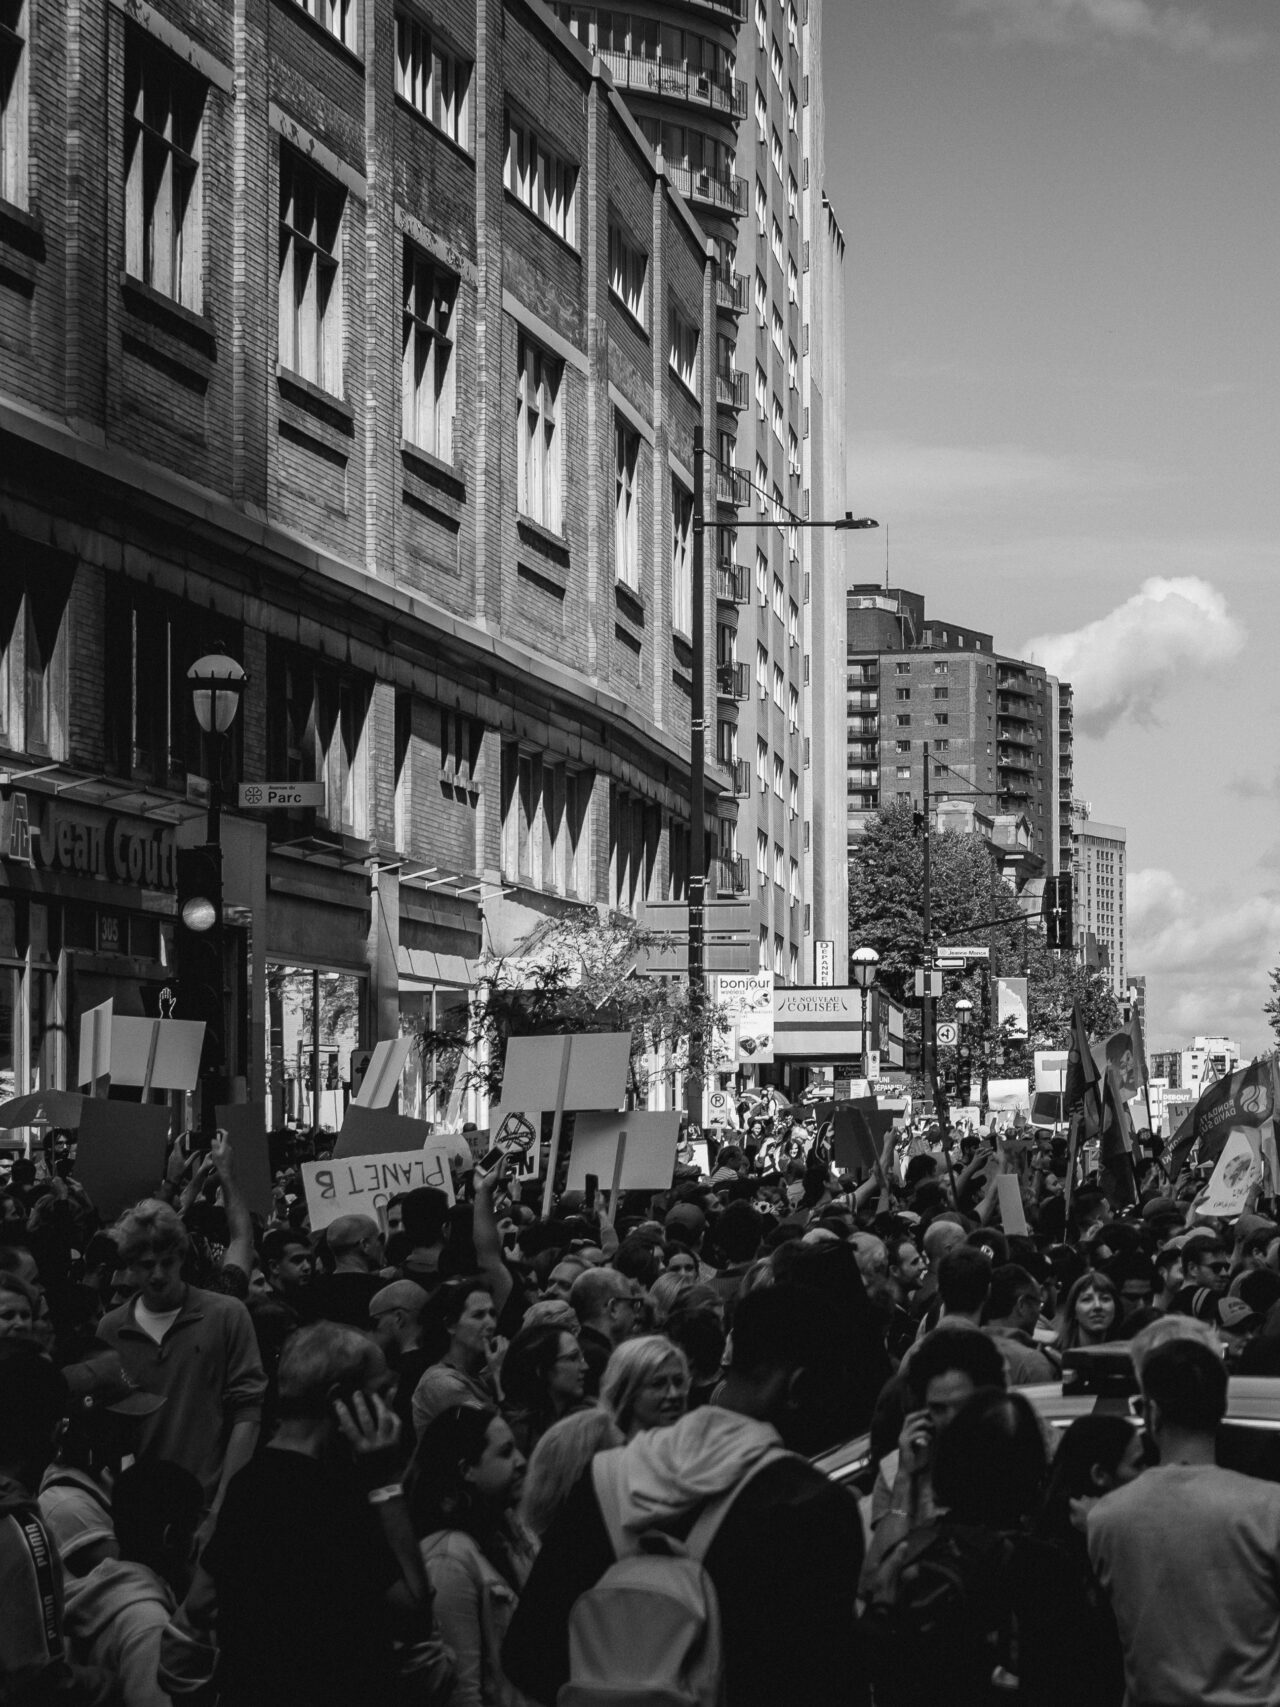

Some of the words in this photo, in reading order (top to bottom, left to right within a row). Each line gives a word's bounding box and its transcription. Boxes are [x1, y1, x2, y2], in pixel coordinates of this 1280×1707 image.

[268, 791, 302, 803] Parc
[40, 800, 107, 877] Jean
[113, 816, 179, 889] Cout
[101, 916, 119, 942] 305
[720, 977, 770, 991] bonjour
[787, 1001, 840, 1012] COLISÉE
[315, 1170, 336, 1199] B
[348, 1155, 445, 1195] PLANET
[24, 1523, 48, 1567] PUMA
